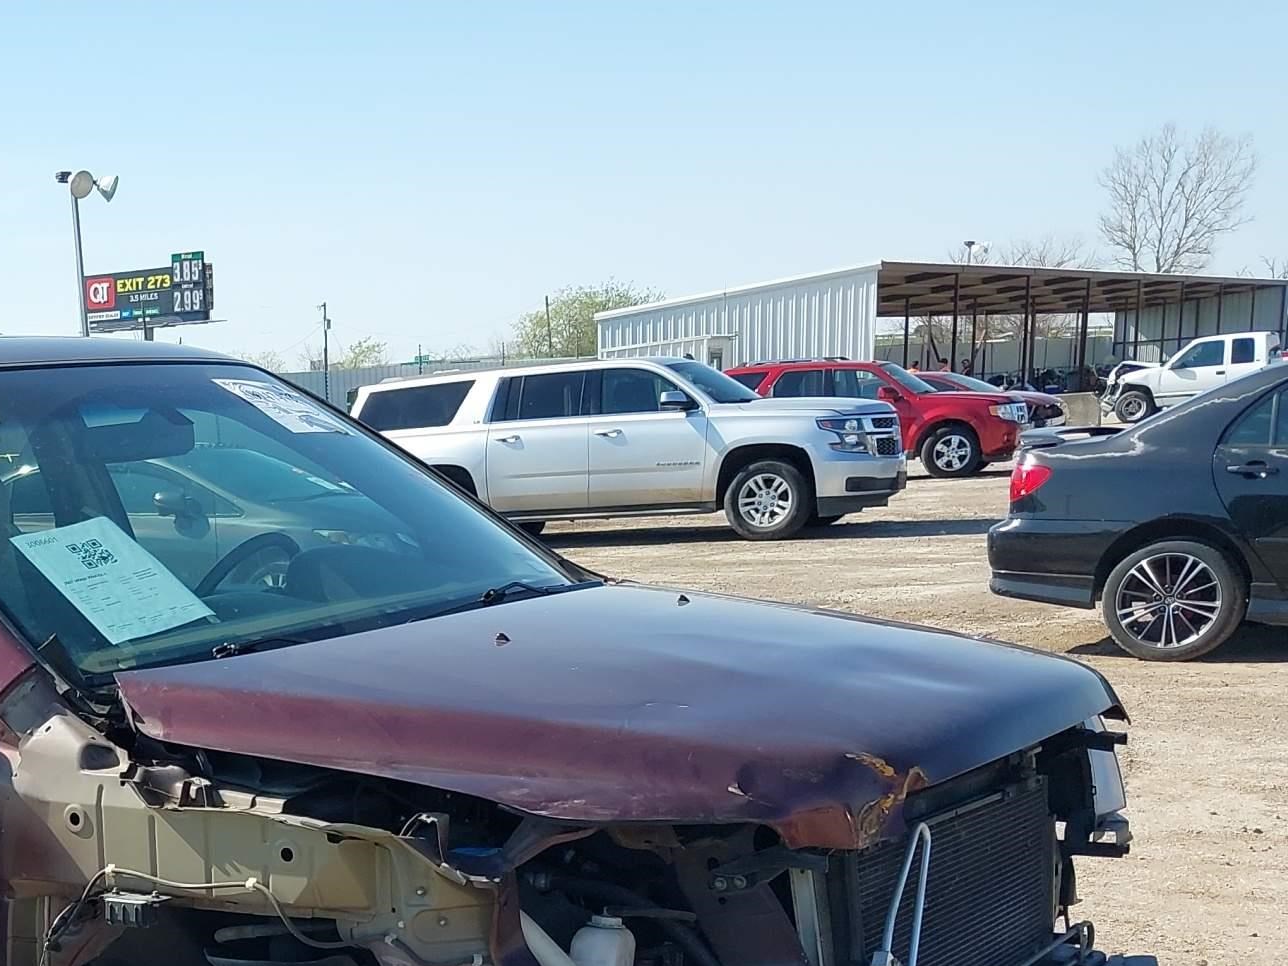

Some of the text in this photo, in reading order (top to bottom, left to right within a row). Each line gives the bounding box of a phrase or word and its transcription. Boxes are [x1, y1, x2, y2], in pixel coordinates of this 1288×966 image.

[89, 282, 110, 304] QT
[116, 275, 170, 292] EXIT 273
